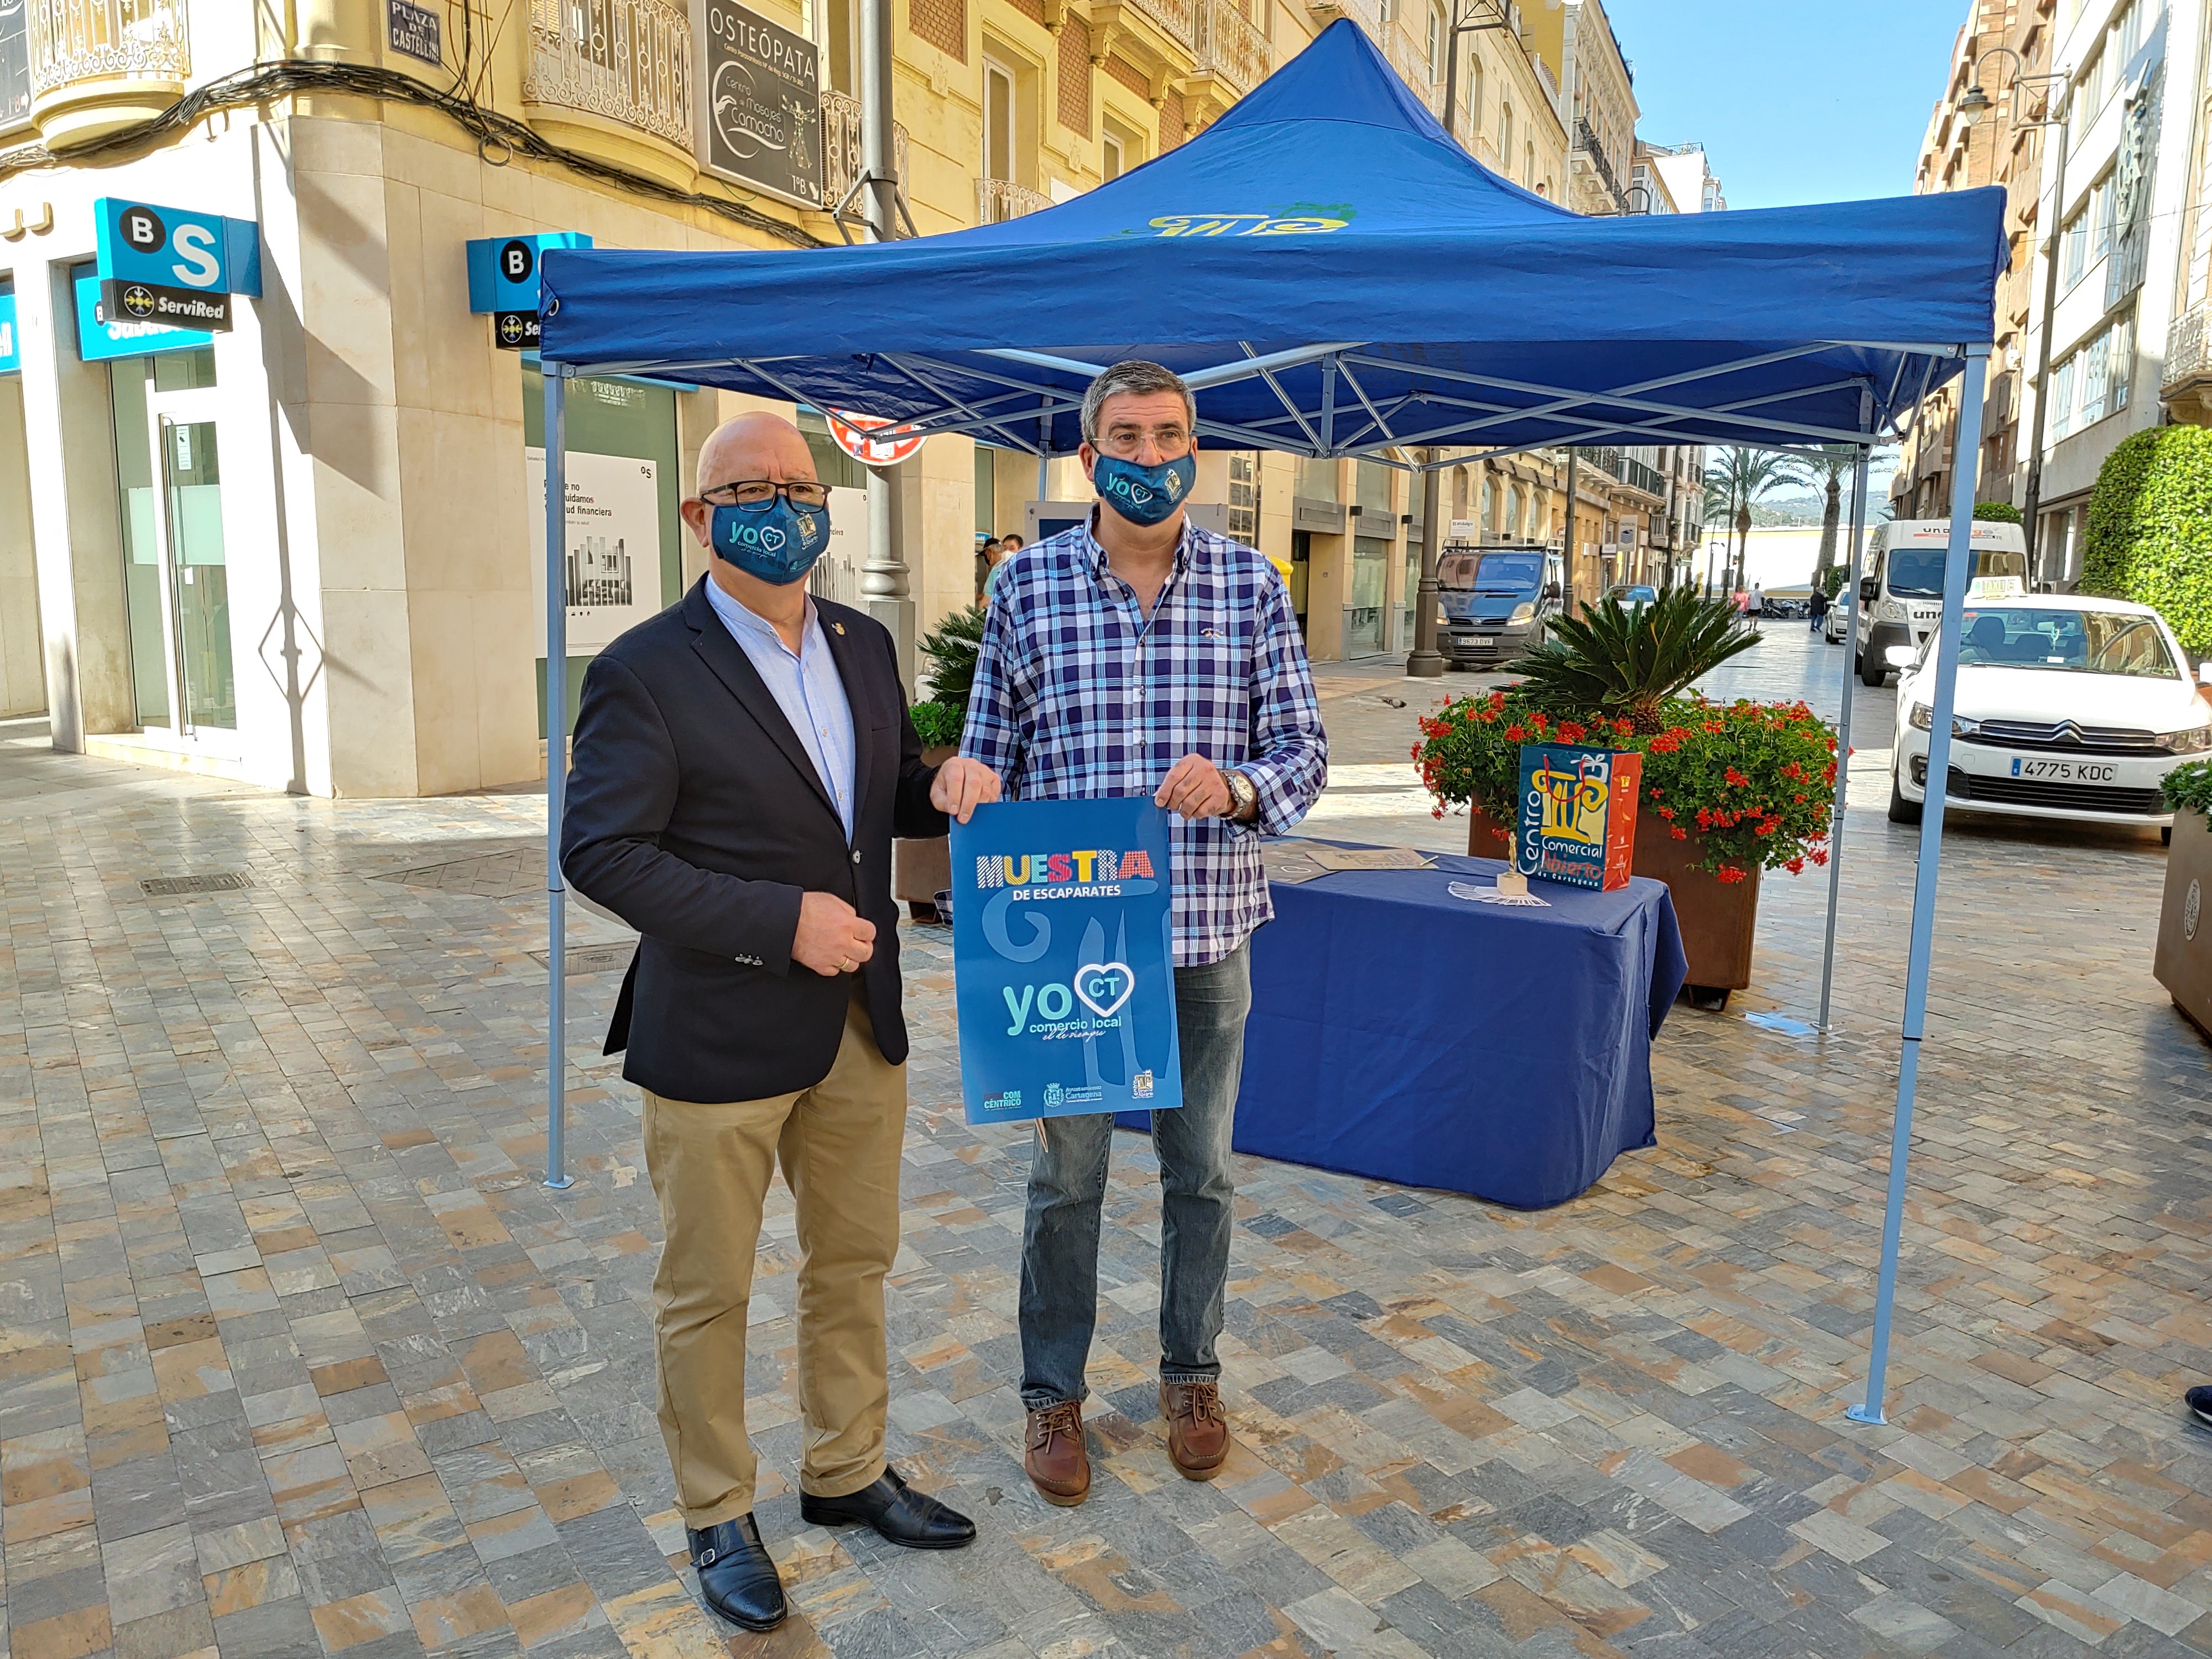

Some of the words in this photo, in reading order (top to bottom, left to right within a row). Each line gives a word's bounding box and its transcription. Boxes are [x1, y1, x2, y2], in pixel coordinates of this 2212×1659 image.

[392, 2, 437, 30] PLAZA
[409, 23, 424, 36] DE
[393, 28, 439, 62] CASTELLINI
[711, 8, 815, 82] OSTEÓPATA
[726, 76, 752, 96] Centro
[731, 107, 784, 143] Camacho
[132, 216, 154, 244] B
[172, 224, 220, 287] S
[508, 251, 524, 274] B
[158, 296, 224, 320] ServiRed
[565, 493, 594, 504] uidamos
[1135, 488, 1149, 498] CT
[577, 505, 612, 517] financiera
[729, 521, 758, 544] yo
[765, 533, 780, 544] CT
[737, 540, 763, 552] comercio
[763, 549, 776, 558] local
[2025, 761, 2070, 778] 4775
[2078, 765, 2113, 781] KDC
[1518, 791, 1541, 875] Centro
[1542, 836, 1603, 859] Comercial
[976, 849, 1155, 889] MUESTRA
[1541, 849, 1601, 880] Abierto
[1552, 873, 1598, 887] Cartagena
[1013, 889, 1030, 901] DE
[1034, 885, 1121, 900] ESCAPARATES
[1089, 977, 1120, 998] CT
[1003, 983, 1072, 1036] yo
[1029, 1018, 1088, 1033] comercio
[1092, 1016, 1121, 1029] local
[1003, 1091, 1021, 1100] COM
[1065, 1091, 1102, 1100] Cartagena
